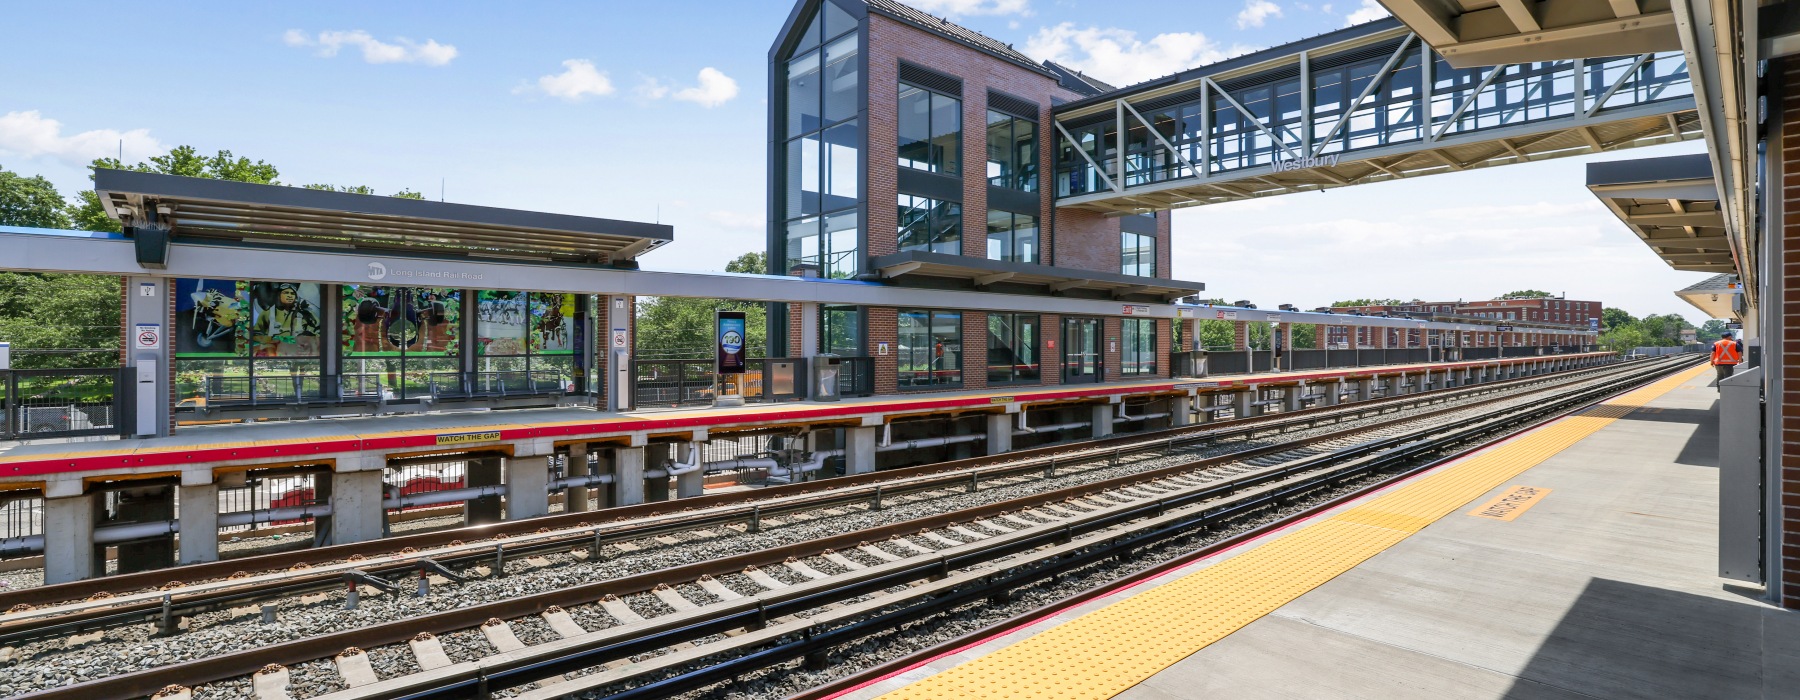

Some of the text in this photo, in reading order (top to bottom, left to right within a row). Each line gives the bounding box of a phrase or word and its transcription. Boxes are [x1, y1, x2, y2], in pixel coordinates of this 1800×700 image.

[1271, 154, 1340, 172] Westbury
[390, 269, 483, 280] Long Island Rail Road
